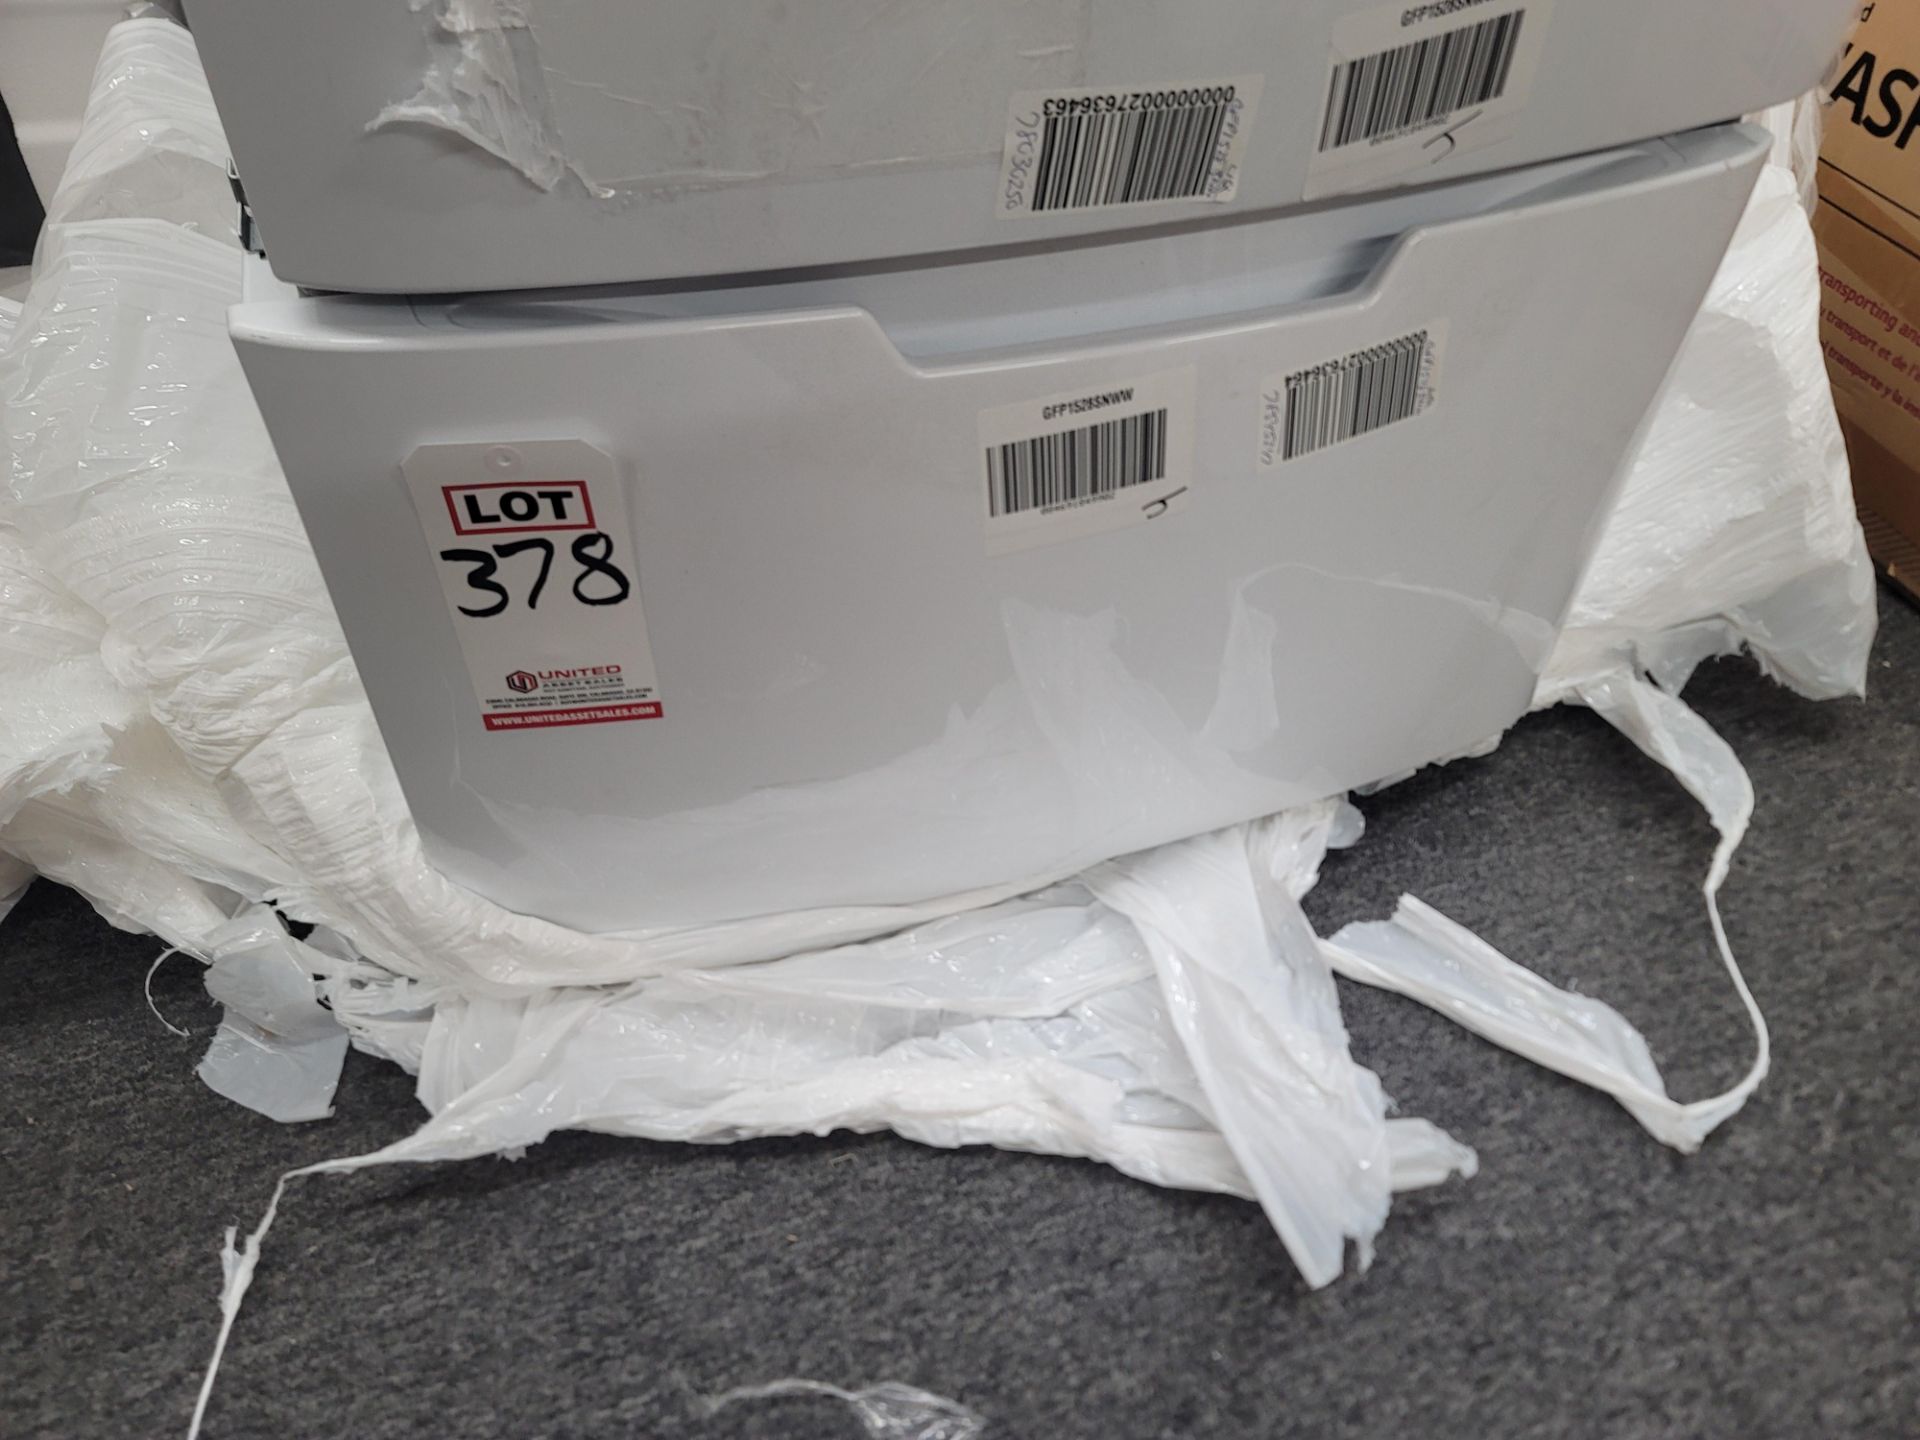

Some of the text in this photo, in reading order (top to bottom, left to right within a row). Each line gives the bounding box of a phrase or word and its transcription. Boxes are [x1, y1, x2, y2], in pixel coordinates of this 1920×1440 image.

[463, 490, 574, 524] LOT
[440, 531, 631, 618] 378
[537, 664, 623, 680] UNITED
[491, 705, 656, 726] WWW.UNITEDASSETSALES.COM
